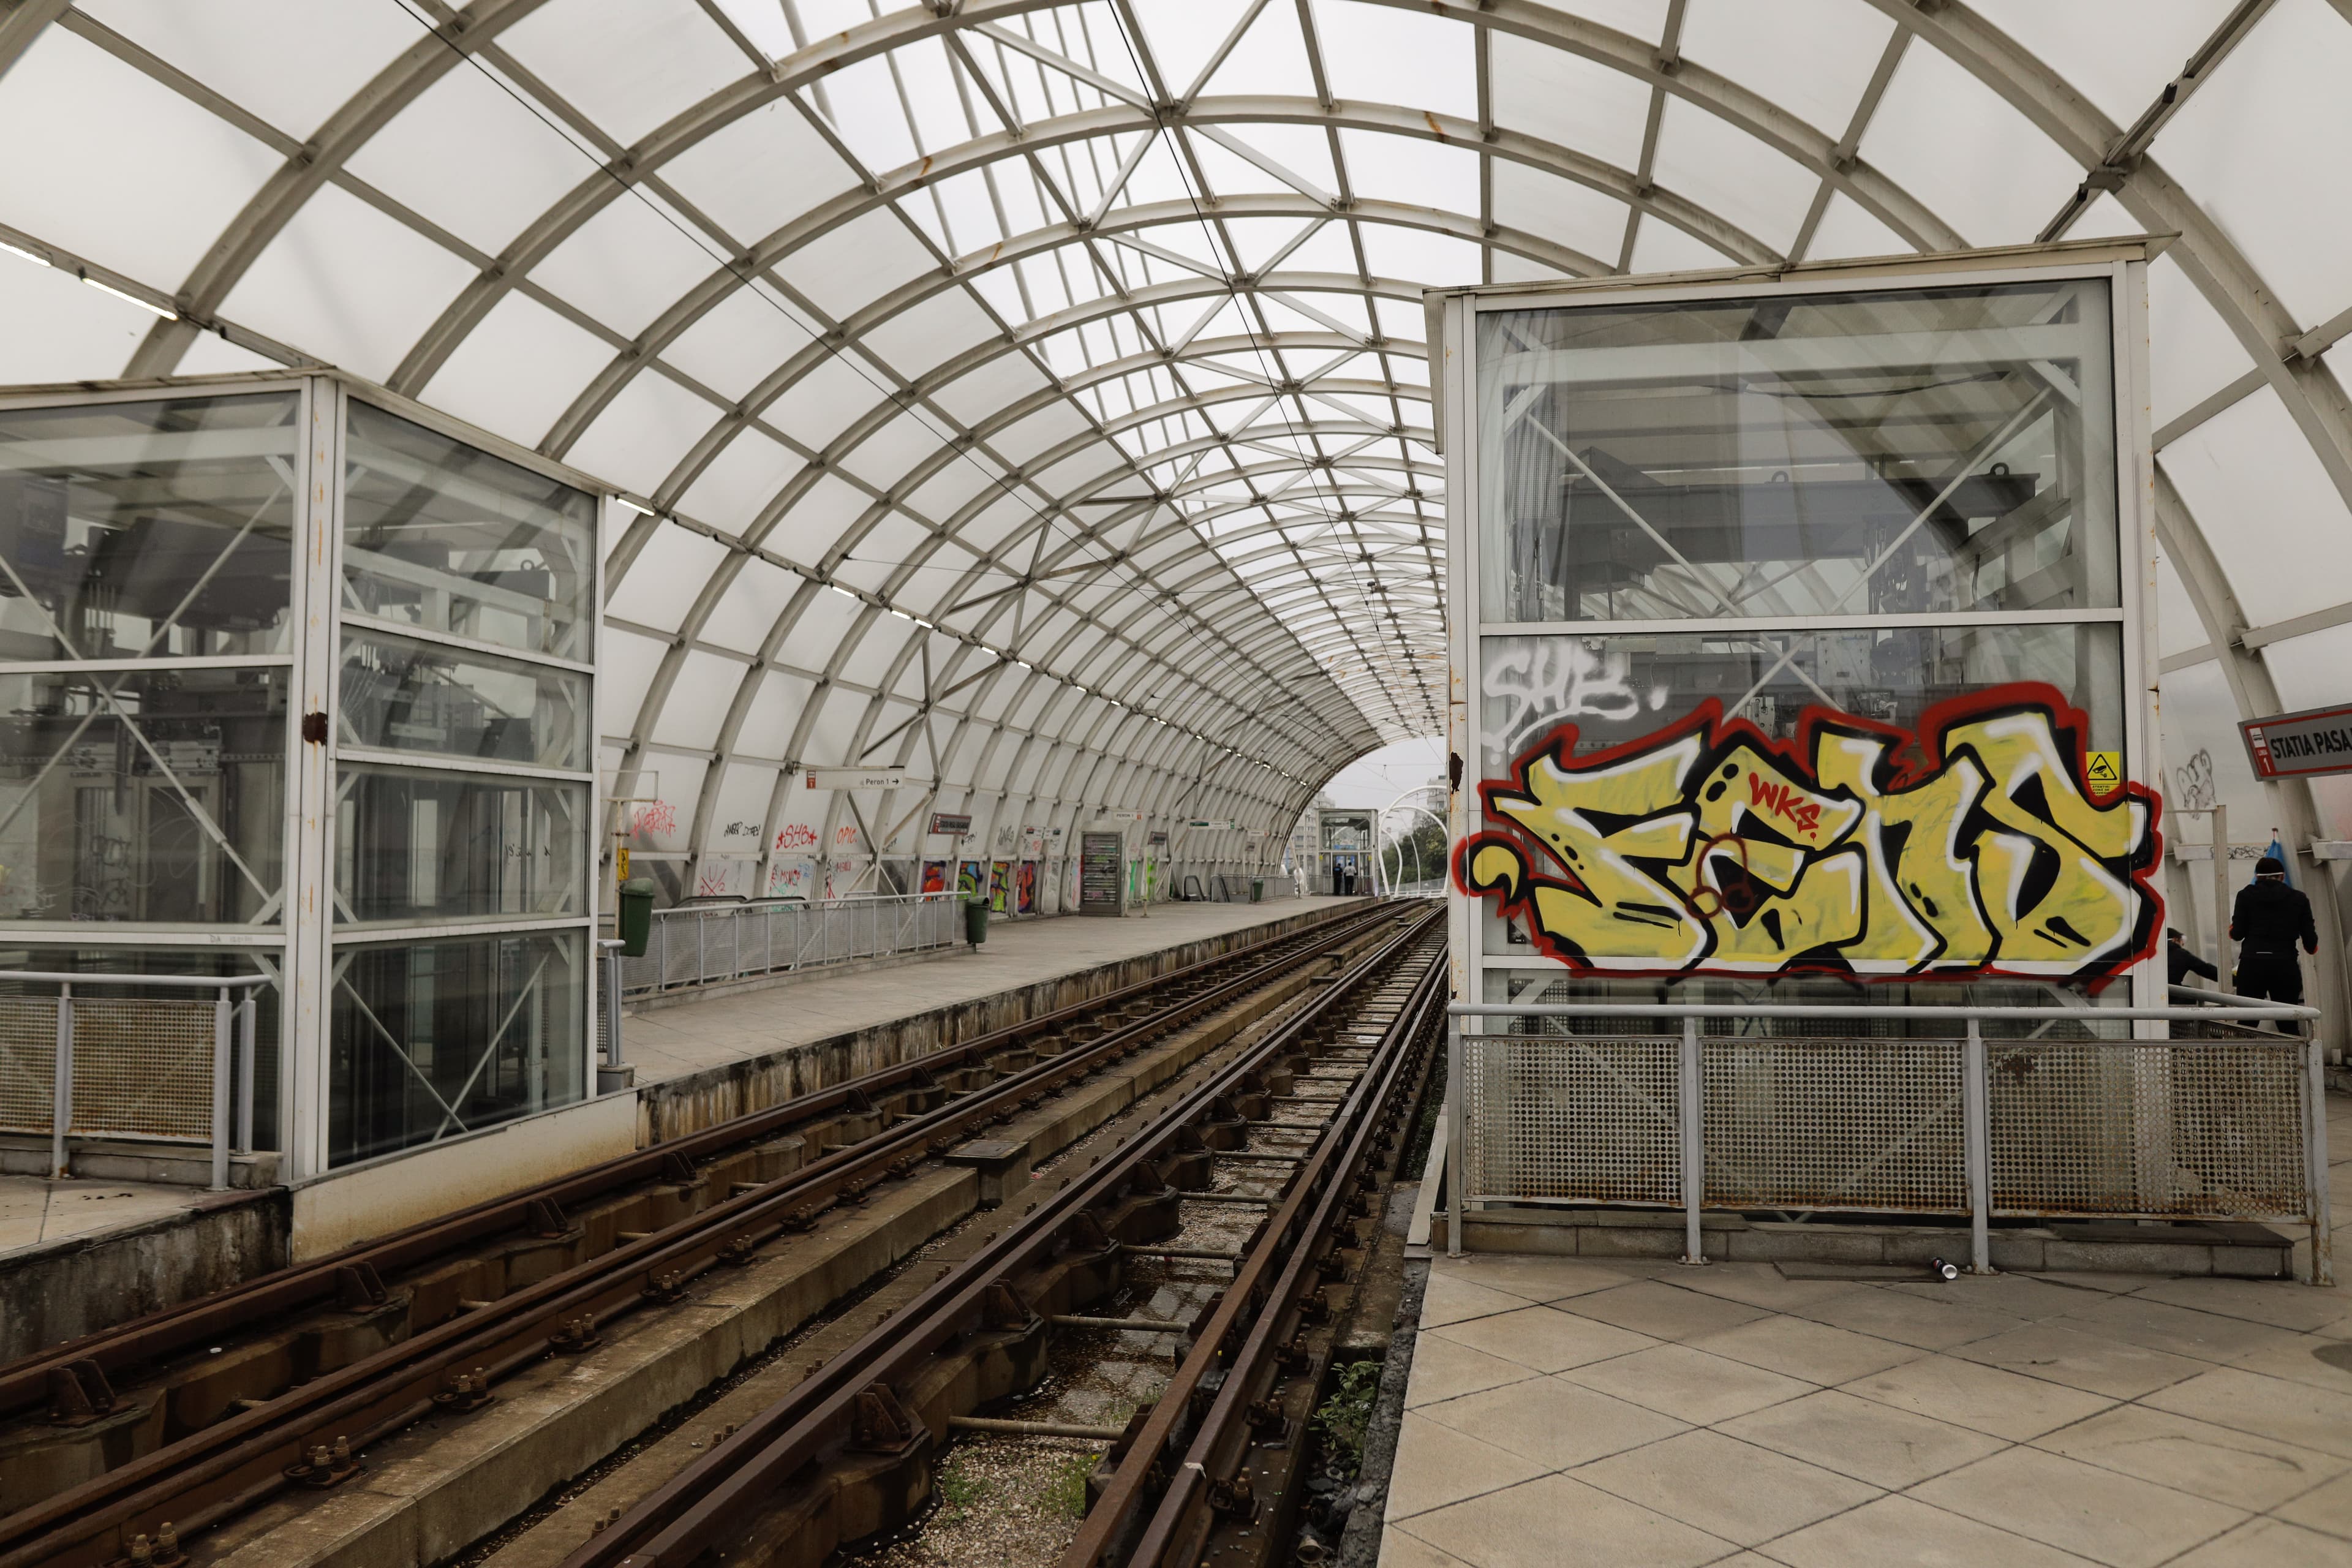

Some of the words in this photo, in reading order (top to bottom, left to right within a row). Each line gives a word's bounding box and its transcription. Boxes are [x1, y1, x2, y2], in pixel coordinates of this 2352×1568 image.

[2270, 734, 2316, 759] STATIA
[2313, 727, 2352, 754] PASA
[2263, 757, 2271, 773] 1
